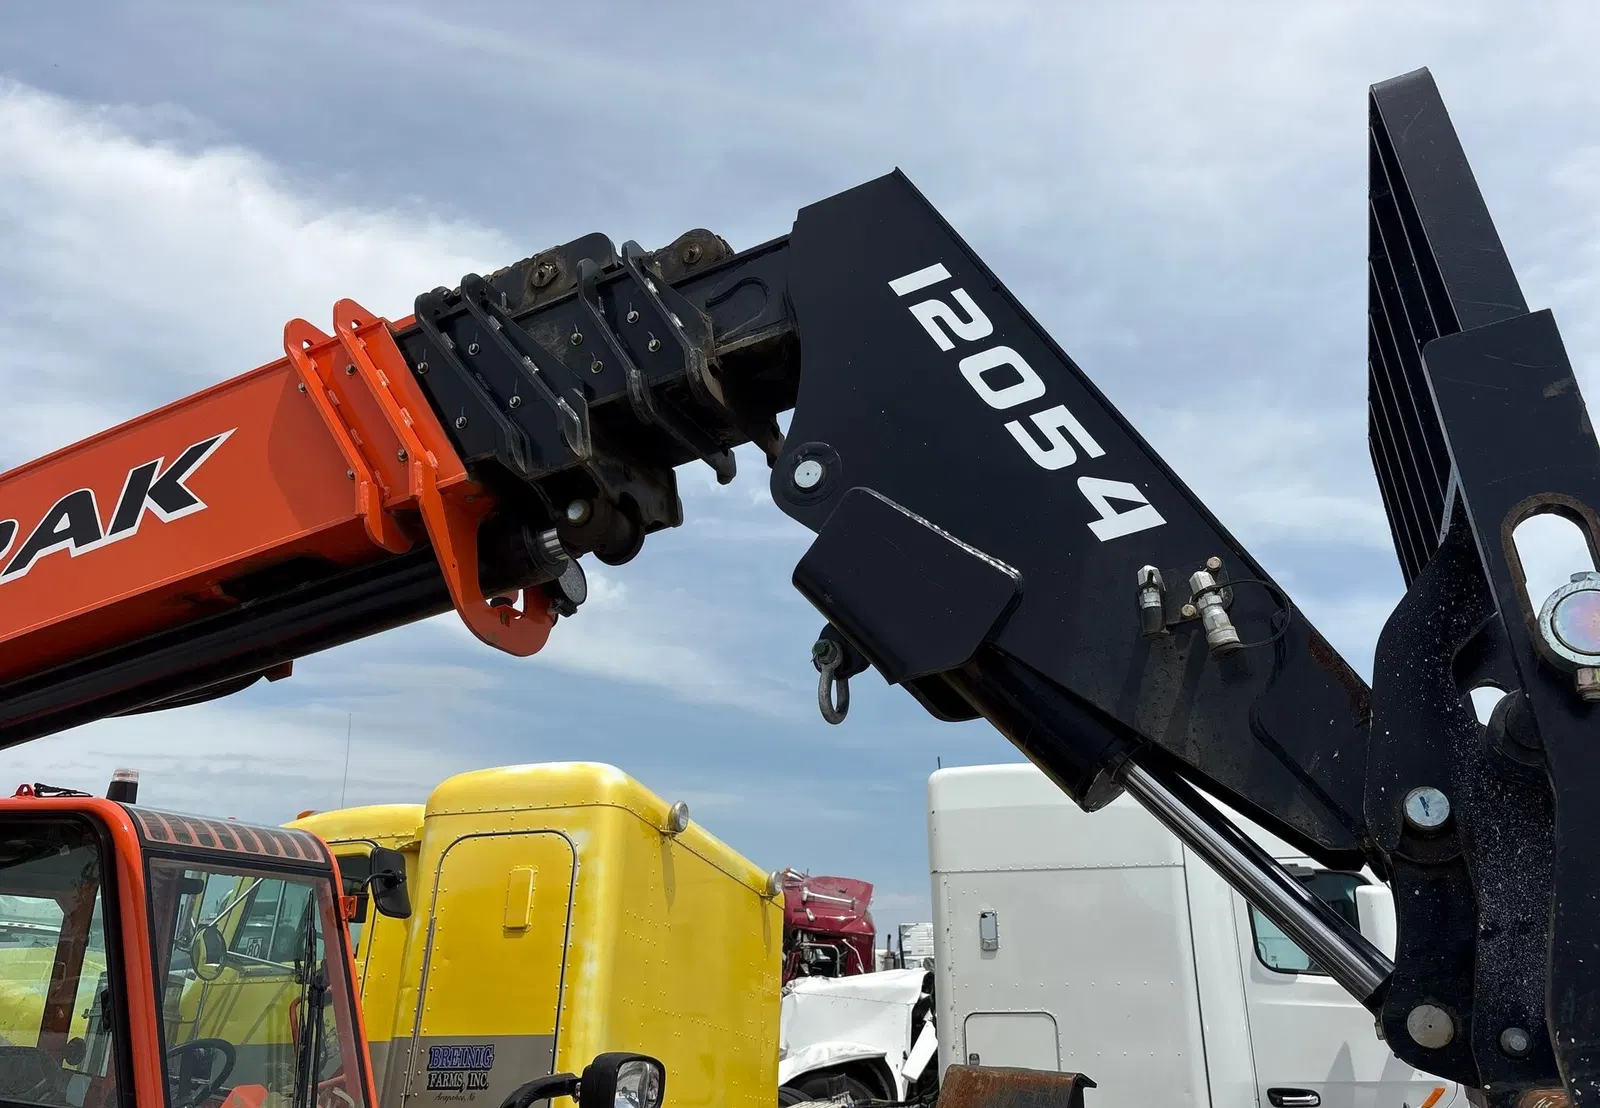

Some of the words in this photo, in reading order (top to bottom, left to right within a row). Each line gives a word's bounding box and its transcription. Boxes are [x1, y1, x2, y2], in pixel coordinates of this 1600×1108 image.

[888, 262, 1168, 542] 12054
[427, 1045, 494, 1071] BREINIG
[427, 1071, 465, 1092] FARMS,
[467, 1071, 489, 1090] INC.
